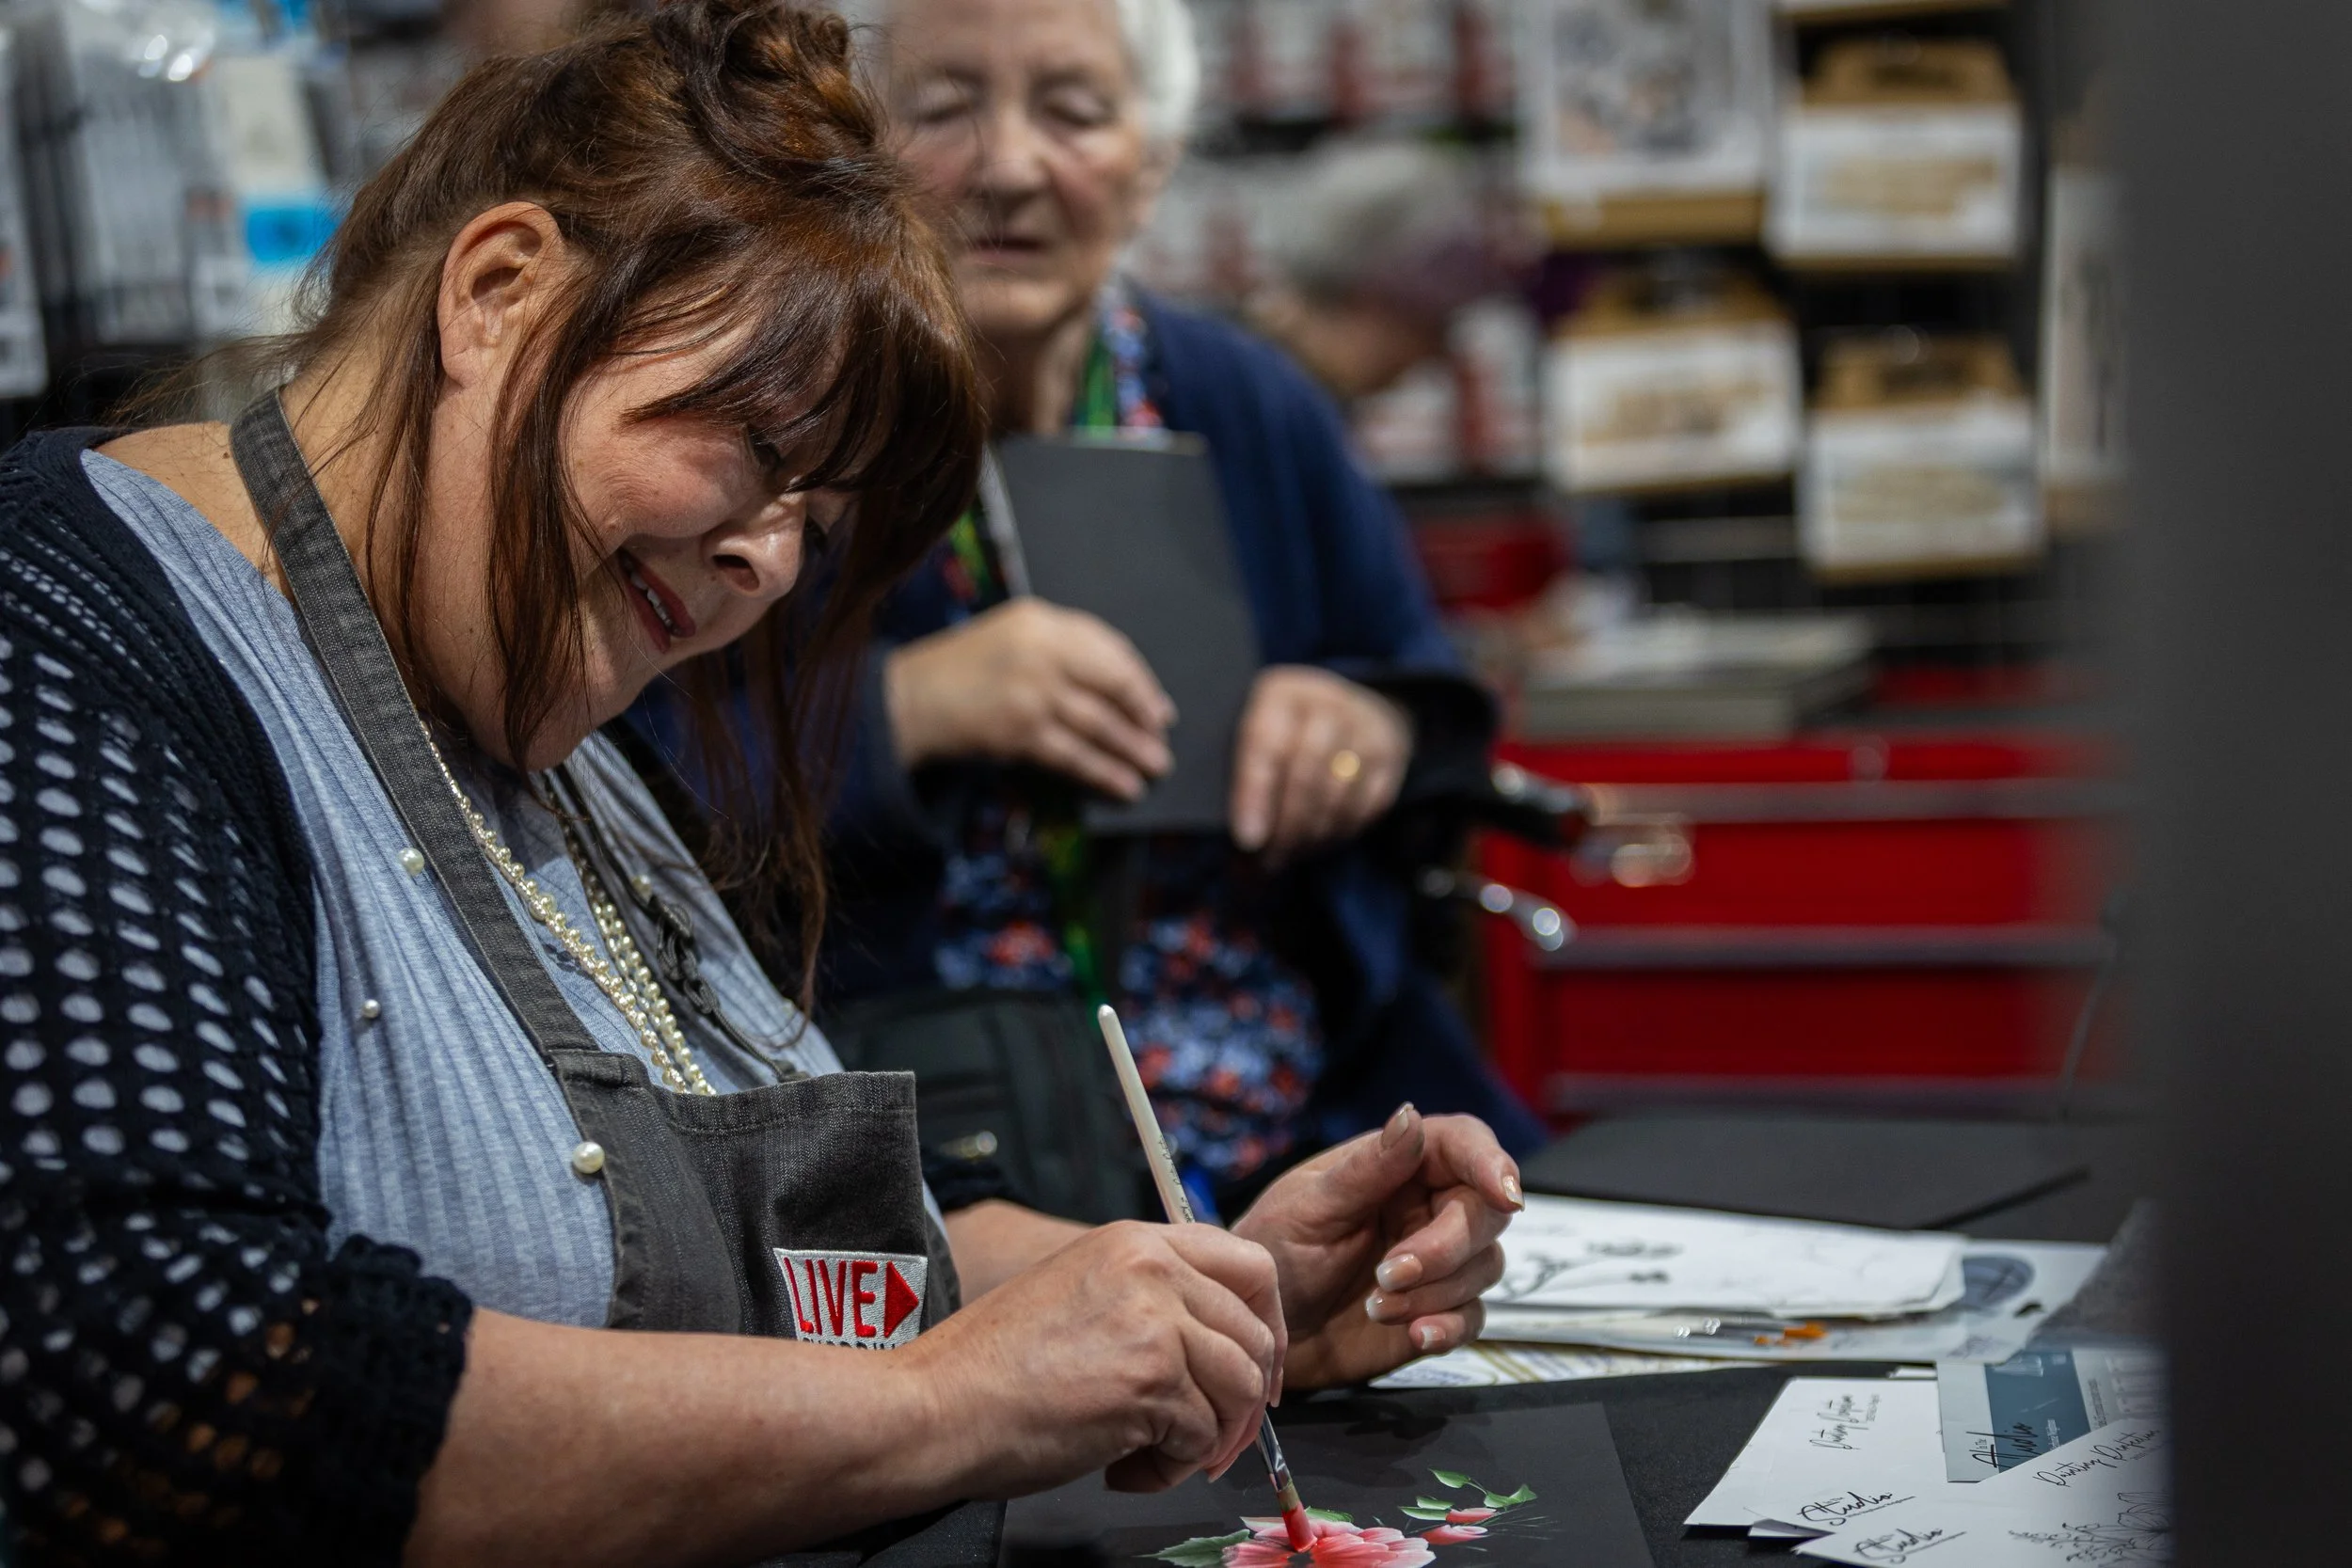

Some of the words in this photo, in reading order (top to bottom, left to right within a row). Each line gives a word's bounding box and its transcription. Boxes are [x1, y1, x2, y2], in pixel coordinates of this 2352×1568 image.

[783, 1257, 878, 1338] LIVE
[2032, 1458, 2118, 1487] Painting
[1796, 1491, 1893, 1526] Studio
[1853, 1528, 1943, 1564] Studio
